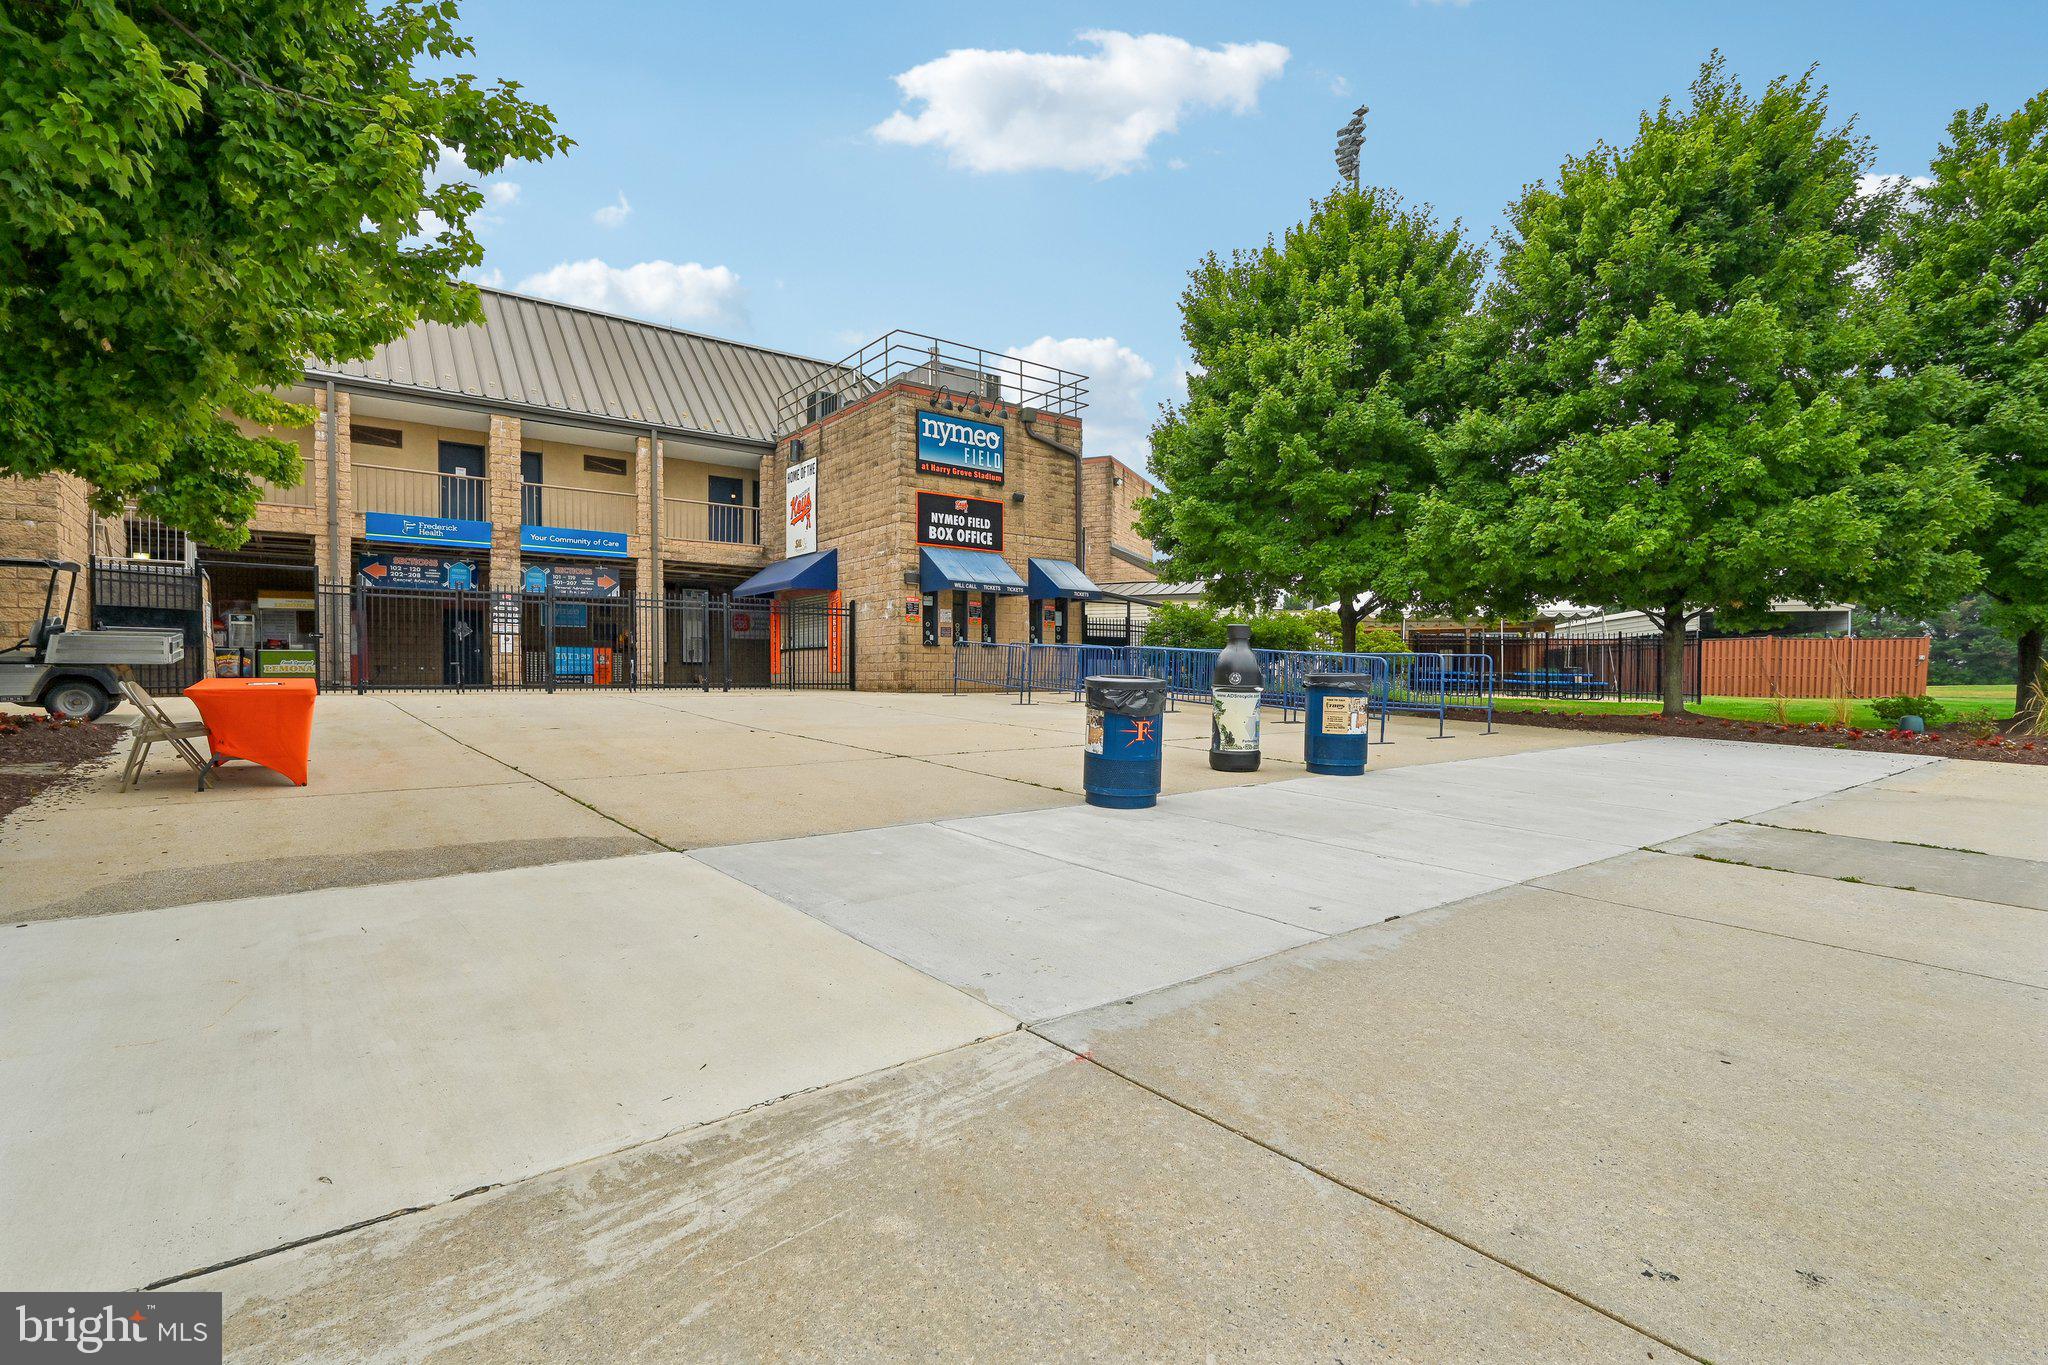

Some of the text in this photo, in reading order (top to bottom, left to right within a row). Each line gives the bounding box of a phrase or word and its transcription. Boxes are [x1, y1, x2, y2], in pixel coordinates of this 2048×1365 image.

[922, 418, 1001, 449] nymeo
[964, 448, 1001, 469] FIELD
[801, 466, 806, 479] OF
[807, 462, 815, 476] THE
[931, 463, 951, 475] Harry
[952, 467, 973, 477] Grove
[974, 472, 1002, 482] Stadium
[418, 522, 458, 532] Frederick
[931, 512, 991, 530] NYMEO FIELD
[418, 529, 444, 537] Health
[530, 533, 547, 541] Your
[549, 535, 592, 547] Community
[928, 525, 993, 545] BOX OFFICE
[393, 556, 439, 567] SECTIONS
[265, 665, 315, 673] LEMONA
